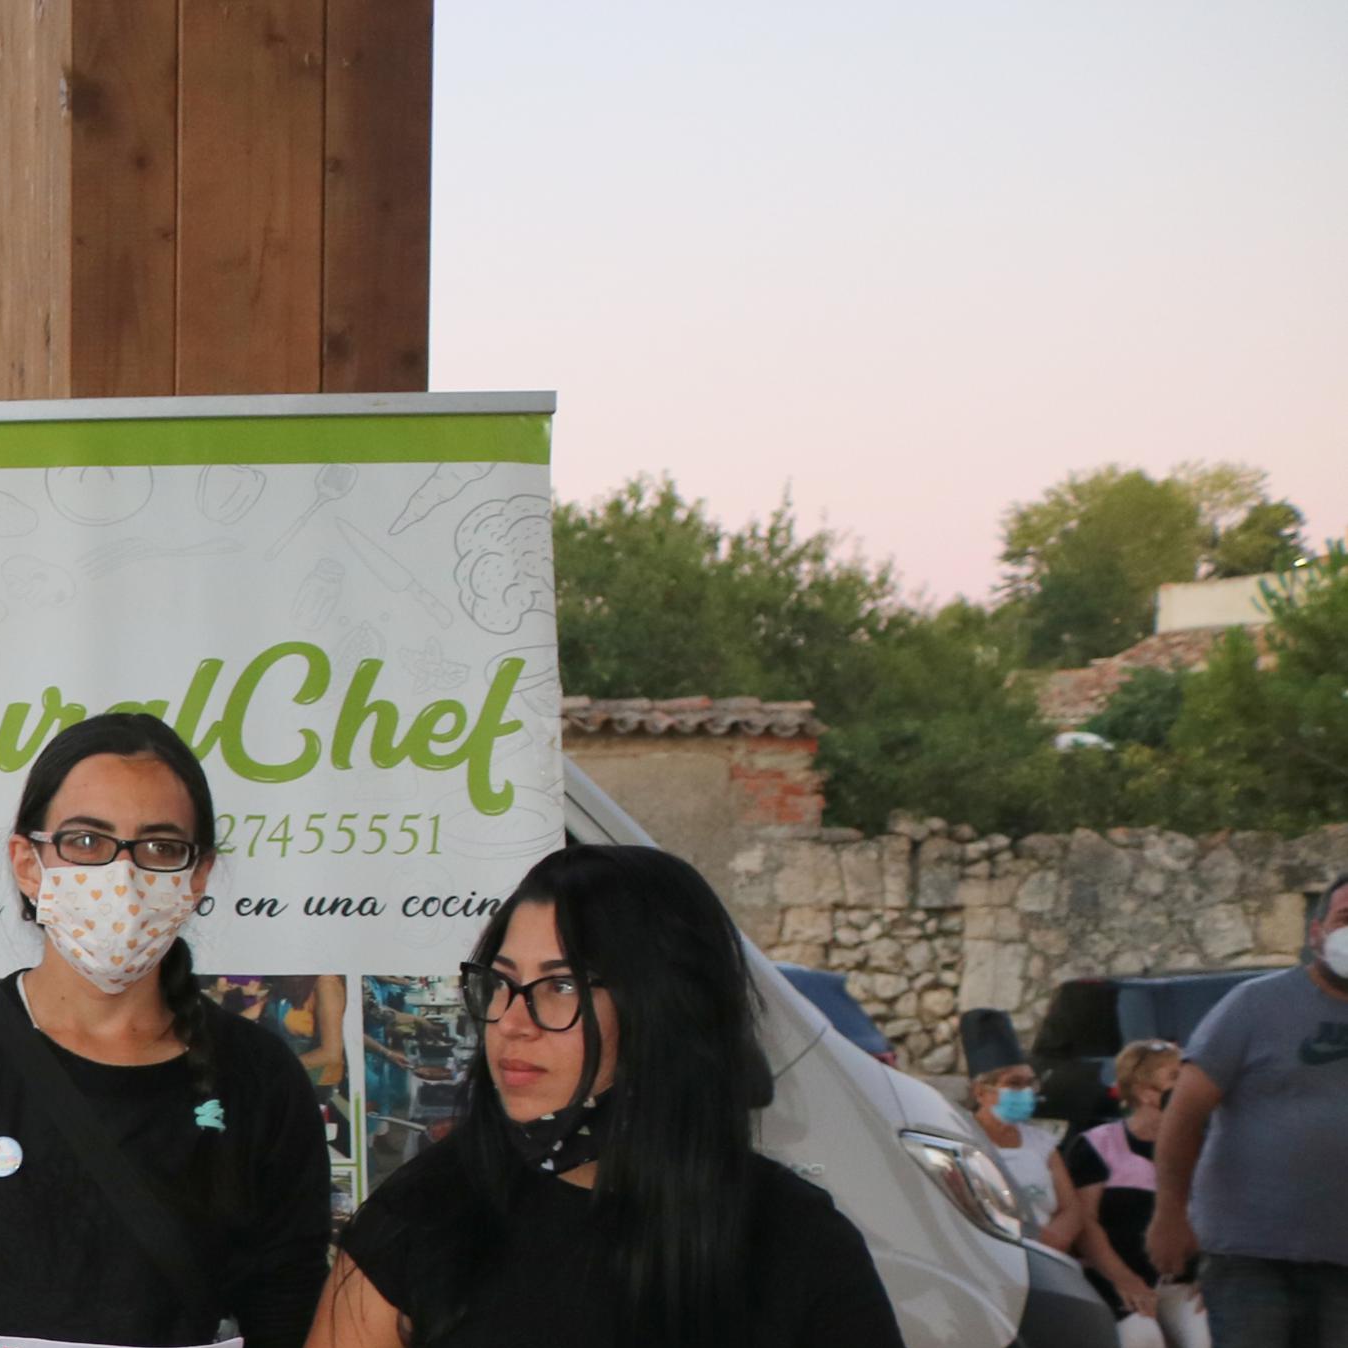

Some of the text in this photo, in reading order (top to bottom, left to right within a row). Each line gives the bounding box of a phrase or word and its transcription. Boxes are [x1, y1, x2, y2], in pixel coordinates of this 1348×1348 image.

[216, 812, 442, 858] 27455551
[235, 895, 289, 918] en
[304, 895, 387, 918] una
[401, 890, 501, 918] cocin
